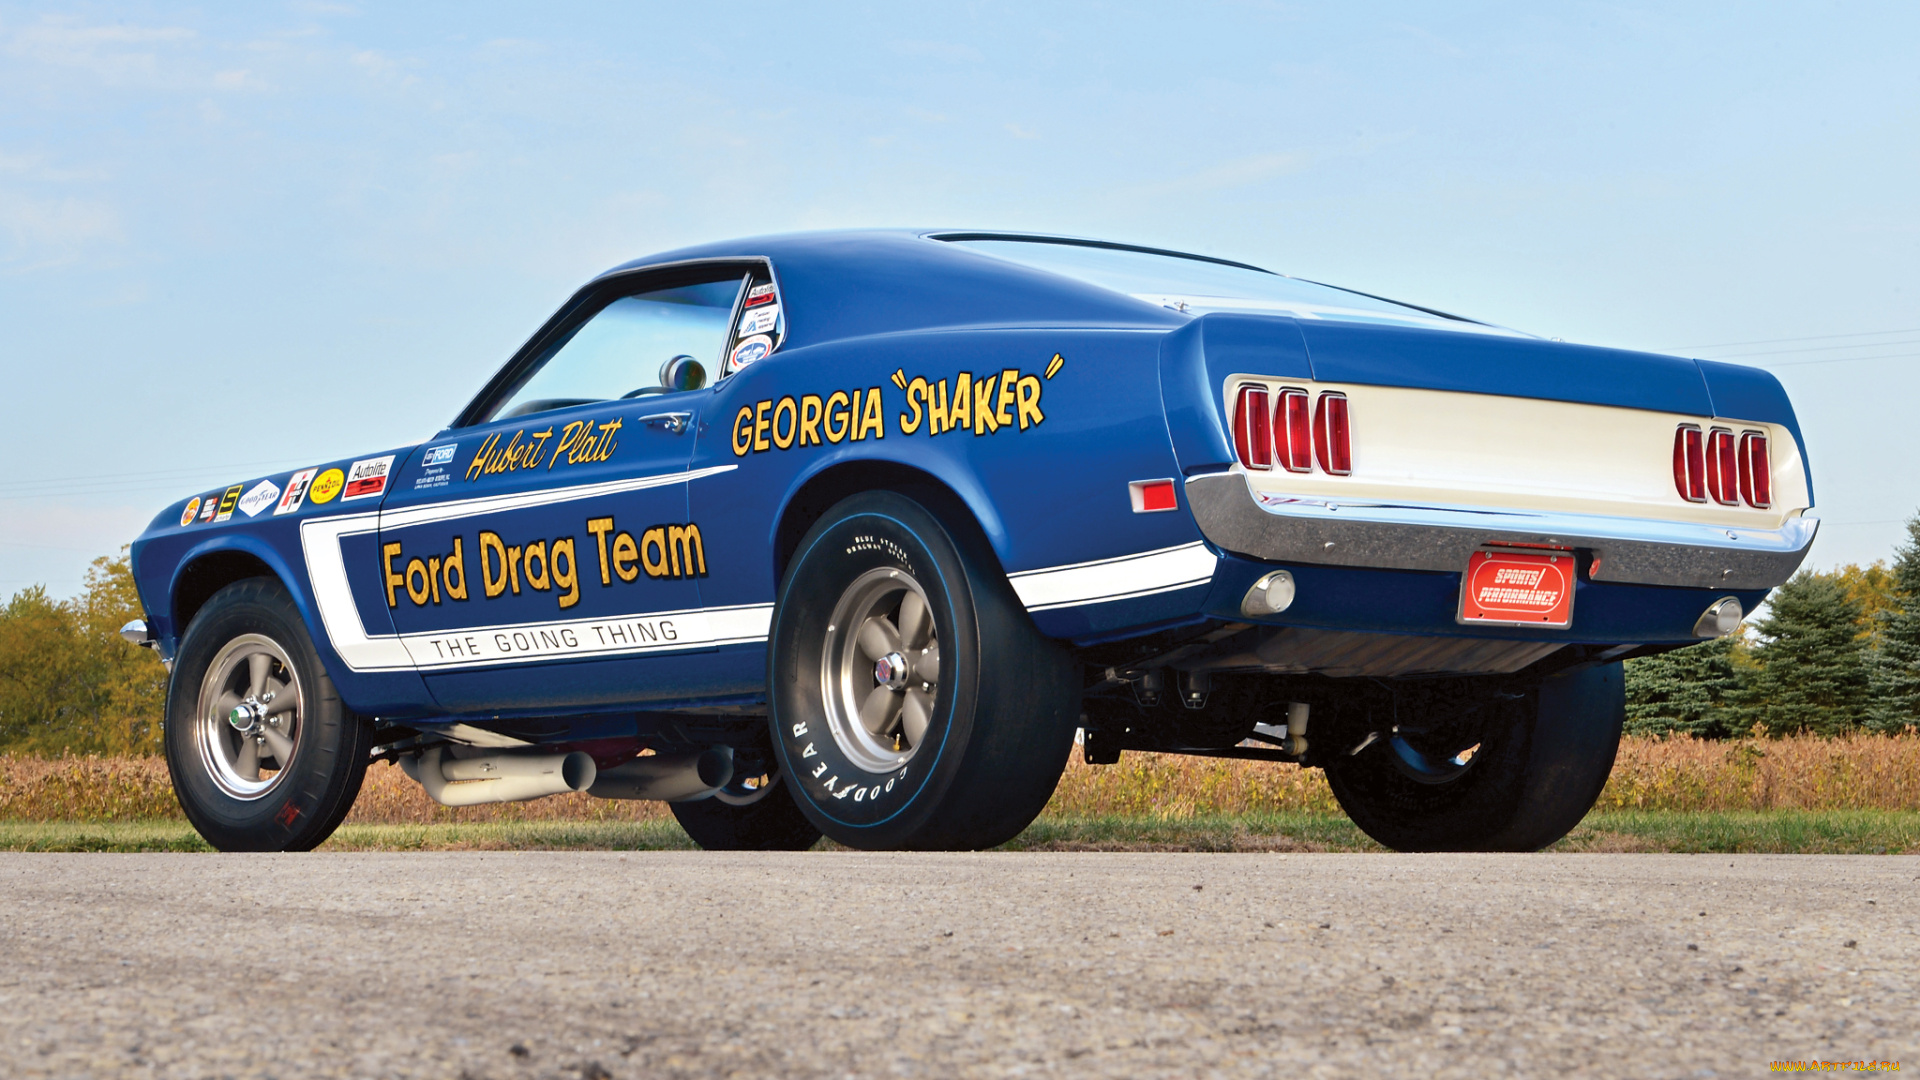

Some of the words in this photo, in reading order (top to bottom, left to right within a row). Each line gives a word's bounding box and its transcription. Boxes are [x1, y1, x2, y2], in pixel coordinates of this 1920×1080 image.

[732, 386, 885, 457] GEORGIA
[891, 353, 1065, 437] "SHAKER"
[435, 447, 454, 460] FORD
[464, 432, 553, 482] Hubert
[548, 417, 623, 471] Platt
[353, 461, 387, 479] Autolite
[313, 479, 340, 492] PENNZOIL
[855, 535, 874, 544] BLUE
[382, 535, 469, 608] Ford
[478, 529, 581, 610] Drag
[586, 516, 709, 587] Team
[1478, 587, 1558, 606] PERFORMANCE
[431, 636, 480, 659] THE
[497, 628, 579, 653] GOING
[591, 620, 679, 645] THING
